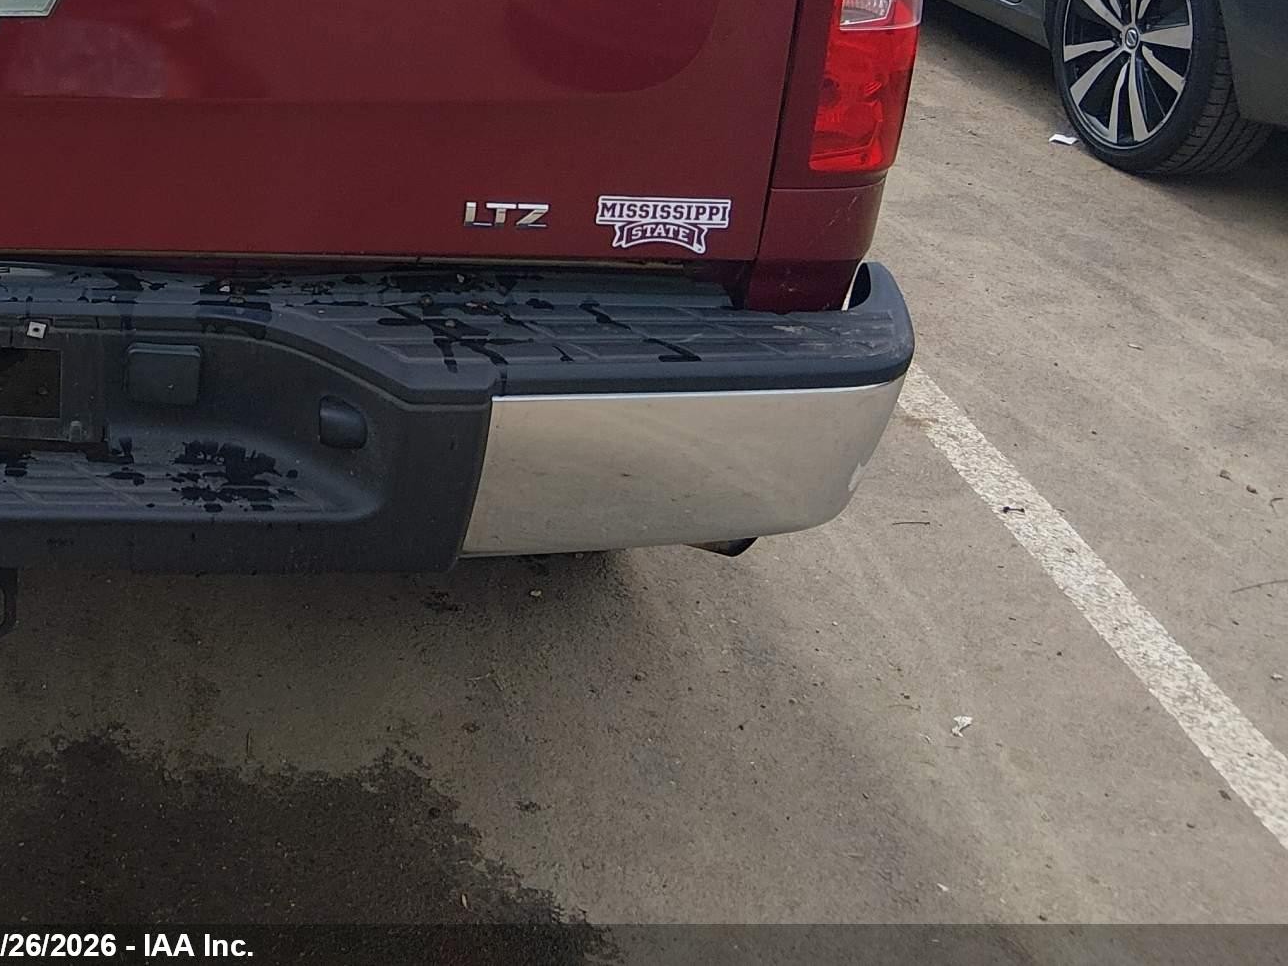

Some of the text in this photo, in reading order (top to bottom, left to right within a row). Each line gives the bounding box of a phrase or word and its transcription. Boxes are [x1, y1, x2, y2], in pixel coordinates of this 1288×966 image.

[463, 201, 550, 228] LTZ
[598, 200, 730, 222] MISSISSIPPI
[631, 223, 690, 243] STATE
